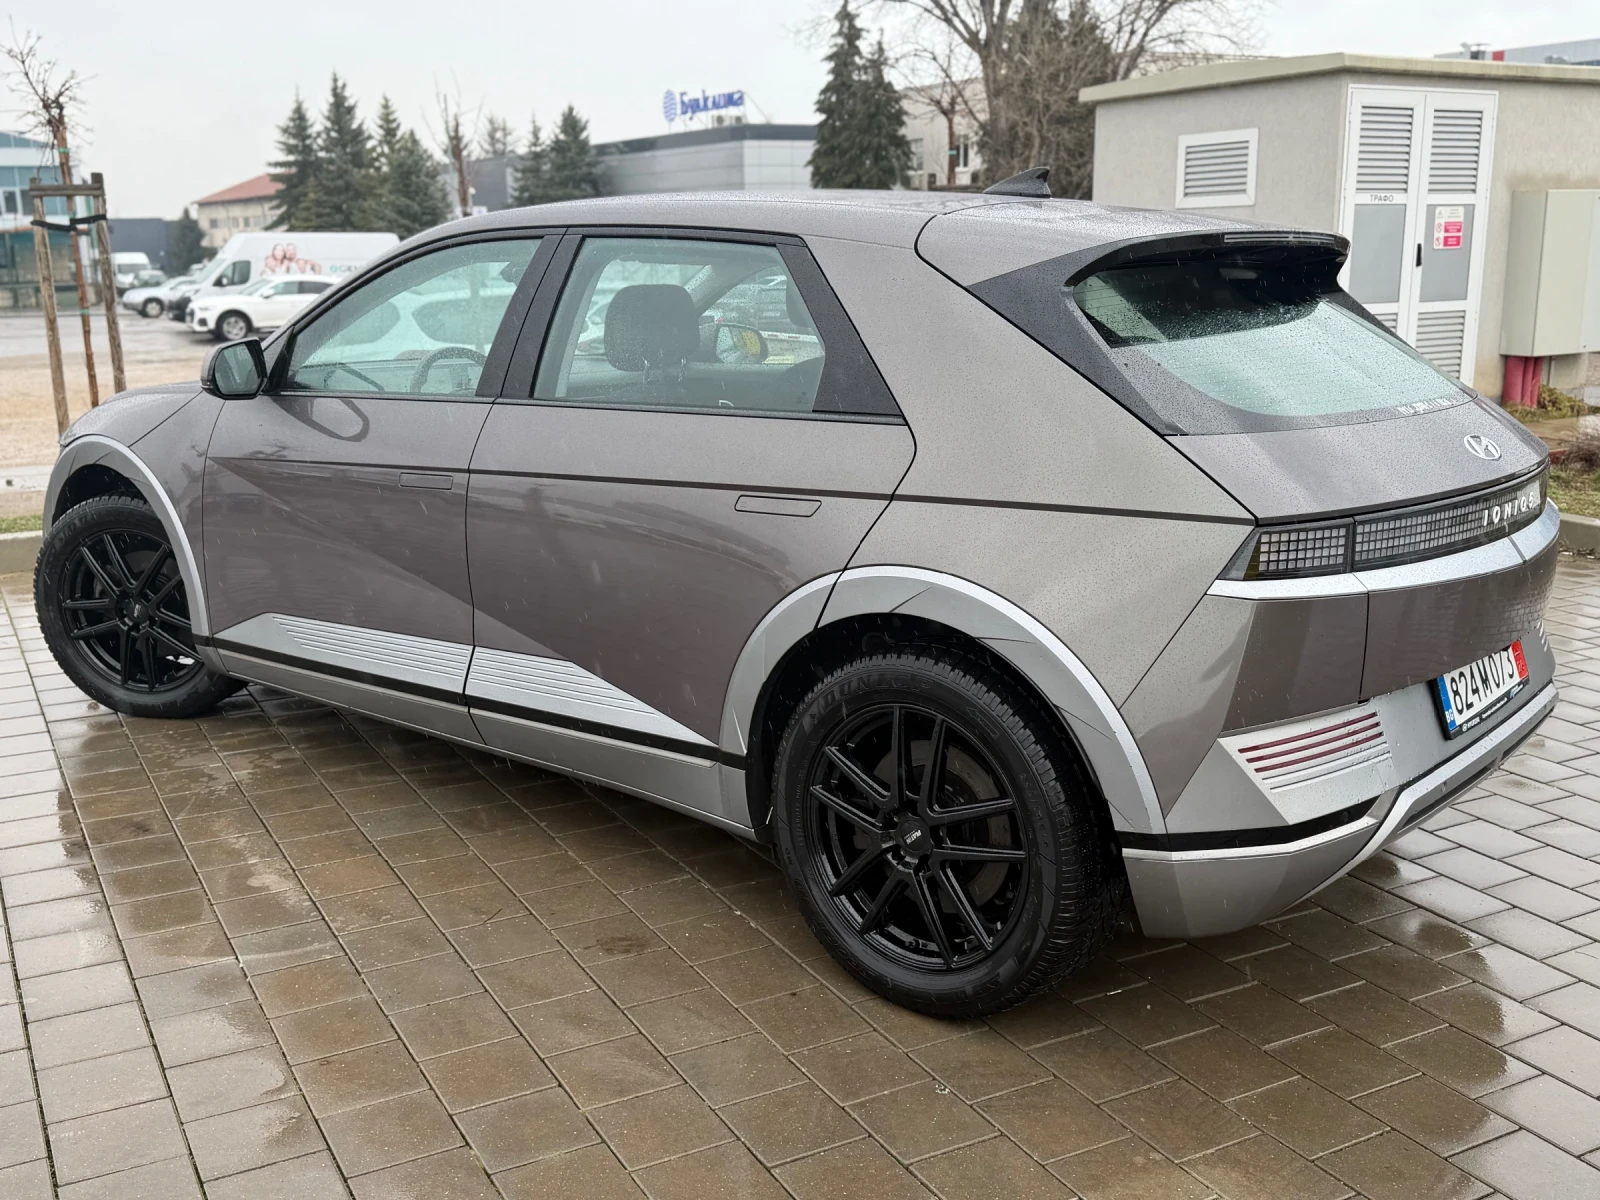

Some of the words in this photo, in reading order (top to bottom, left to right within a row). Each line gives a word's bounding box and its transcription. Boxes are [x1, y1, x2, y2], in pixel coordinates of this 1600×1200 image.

[1370, 194, 1395, 203] ТРАФО
[820, 671, 933, 708] DUNLOP
[1450, 652, 1515, 715] 824M073
[1446, 708, 1454, 724] BG
